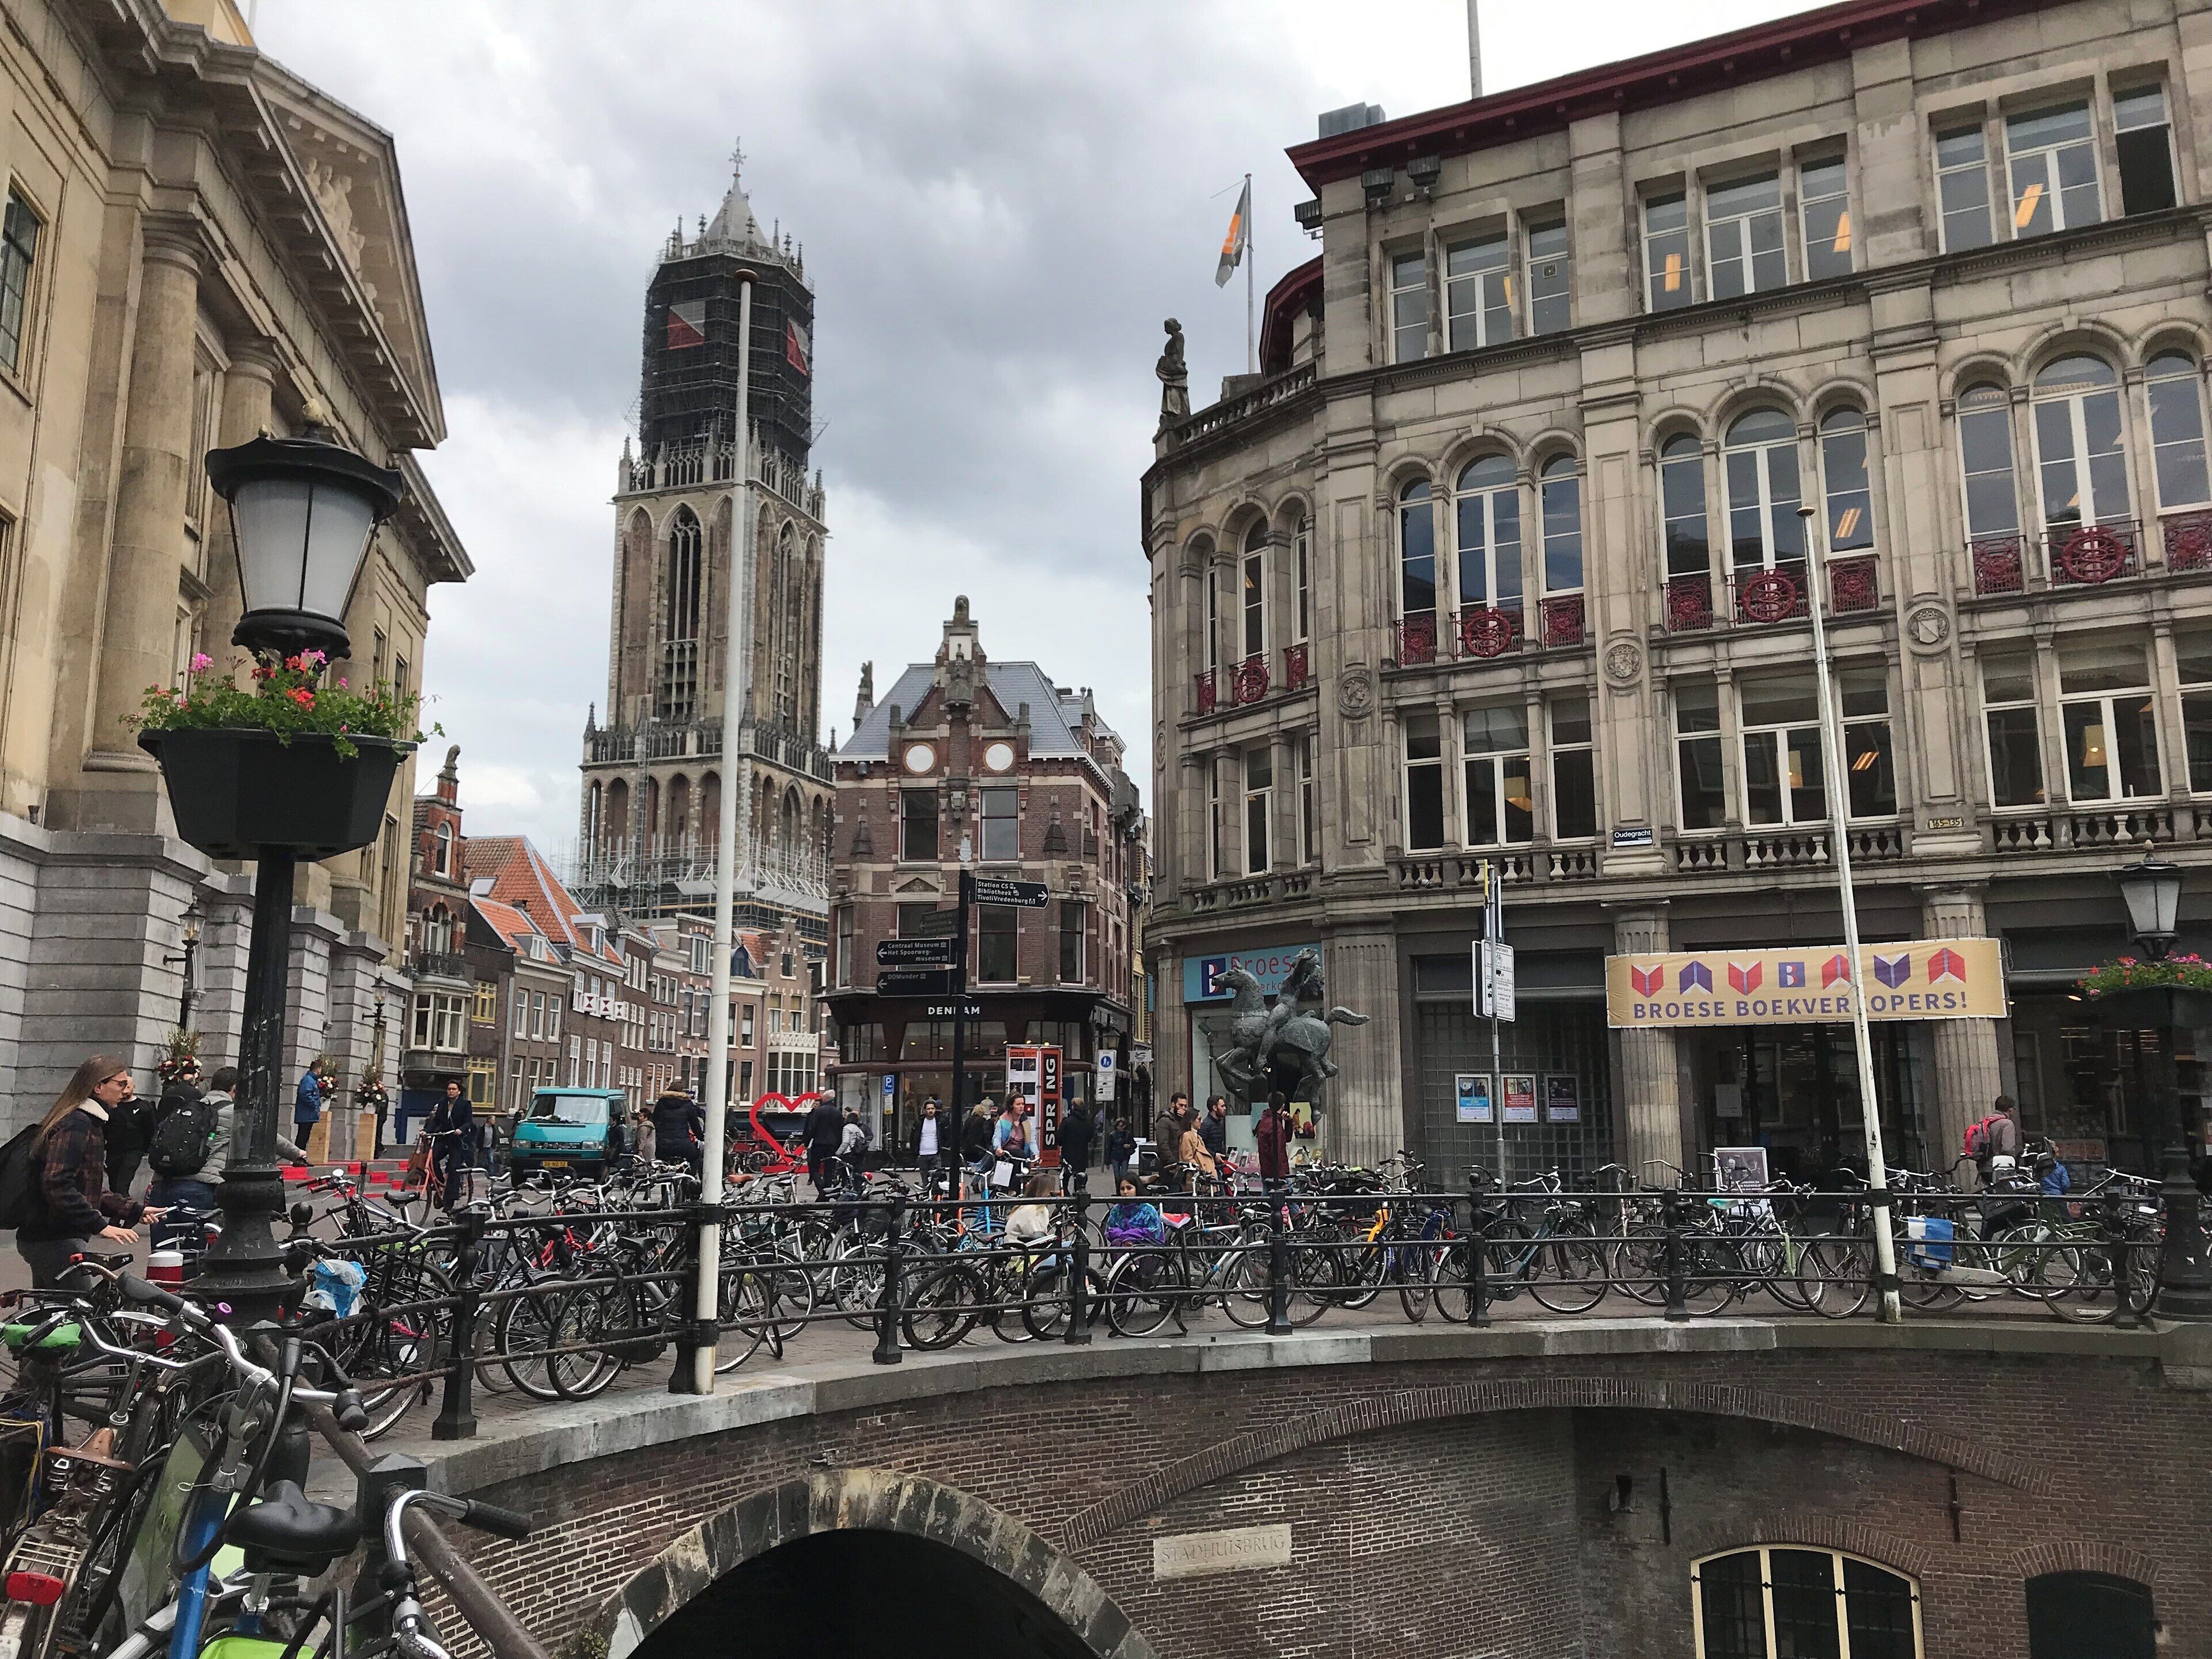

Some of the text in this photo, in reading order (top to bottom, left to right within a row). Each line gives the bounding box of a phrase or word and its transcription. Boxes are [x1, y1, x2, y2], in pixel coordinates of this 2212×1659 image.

[1614, 830, 1652, 838] Oudegracht
[977, 888, 1012, 896] Bibliotheek
[977, 895, 1028, 905] TivoliVredenburg
[1634, 991, 1967, 1018] BROESE BOEKVEROPERS!
[928, 1006, 980, 1015] DENAM
[885, 1077, 892, 1087] P
[1162, 1535, 1285, 1563] STADHUISBRUG
